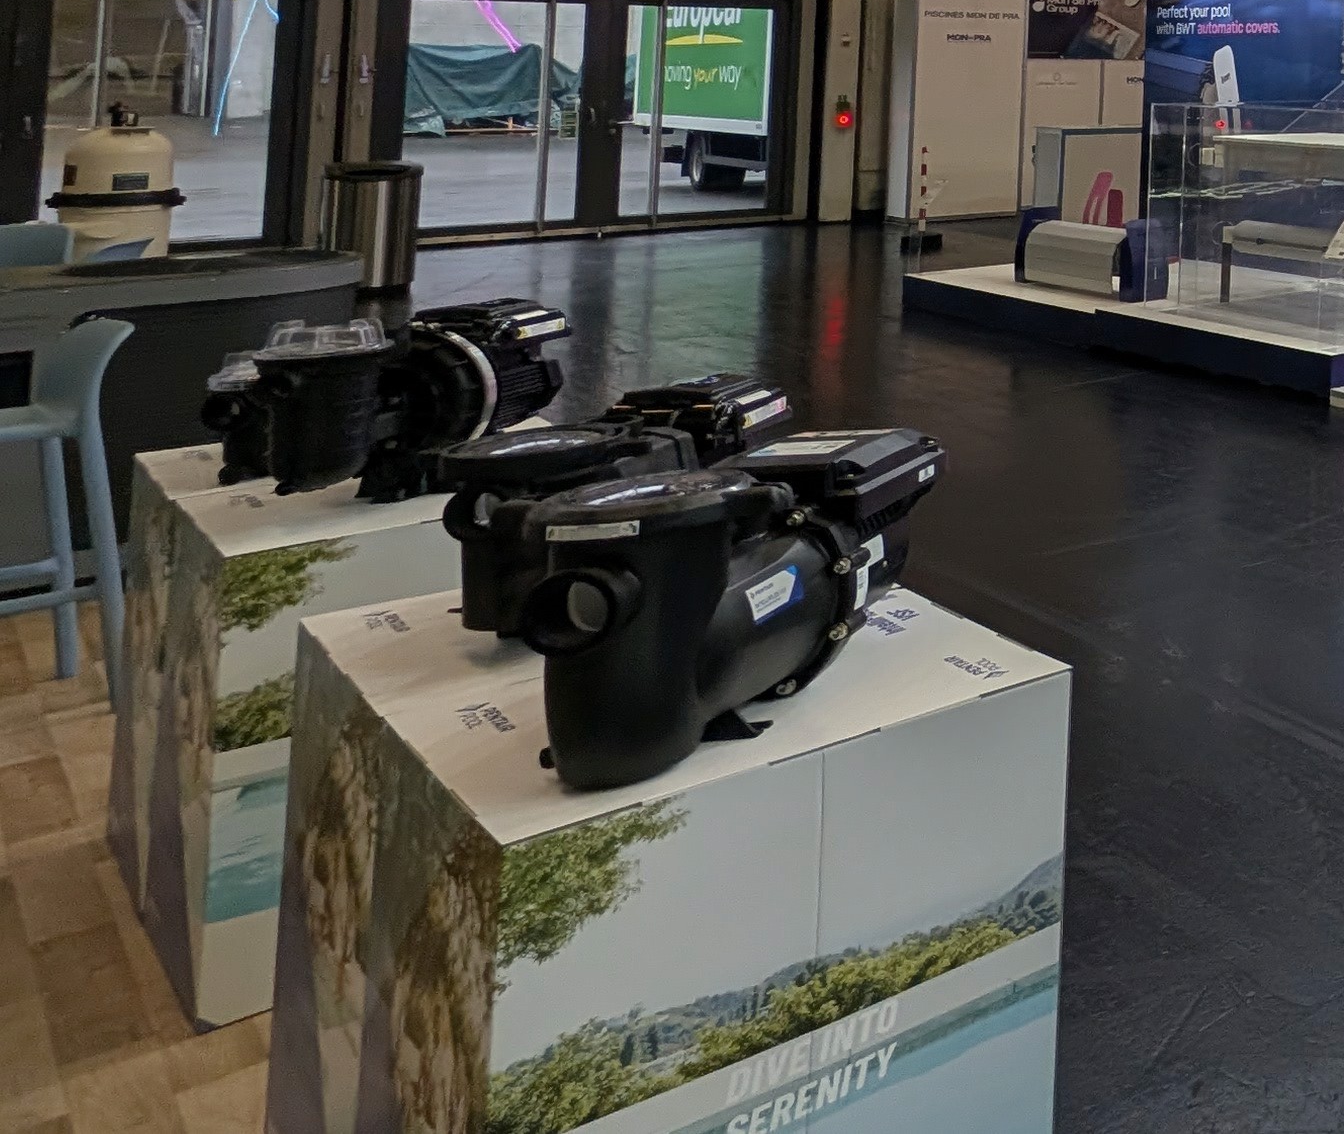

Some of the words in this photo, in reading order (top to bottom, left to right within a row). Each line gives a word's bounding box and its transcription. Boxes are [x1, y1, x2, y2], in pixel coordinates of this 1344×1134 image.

[924, 10, 964, 19] PISCINES
[1046, 4, 1078, 14] Group
[1157, 4, 1188, 19] Perfect
[1189, 5, 1209, 20] your
[1210, 3, 1231, 20] pool
[1156, 22, 1175, 35] with
[1176, 22, 1195, 35] BWT
[1197, 20, 1244, 34] automatic
[1245, 22, 1280, 34] covers.
[665, 62, 692, 90] oving
[693, 67, 718, 89] your
[718, 65, 743, 91] way
[726, 1036, 811, 1107] DIVE
[819, 997, 898, 1064] INTO
[727, 1041, 898, 1134] SERENITY
